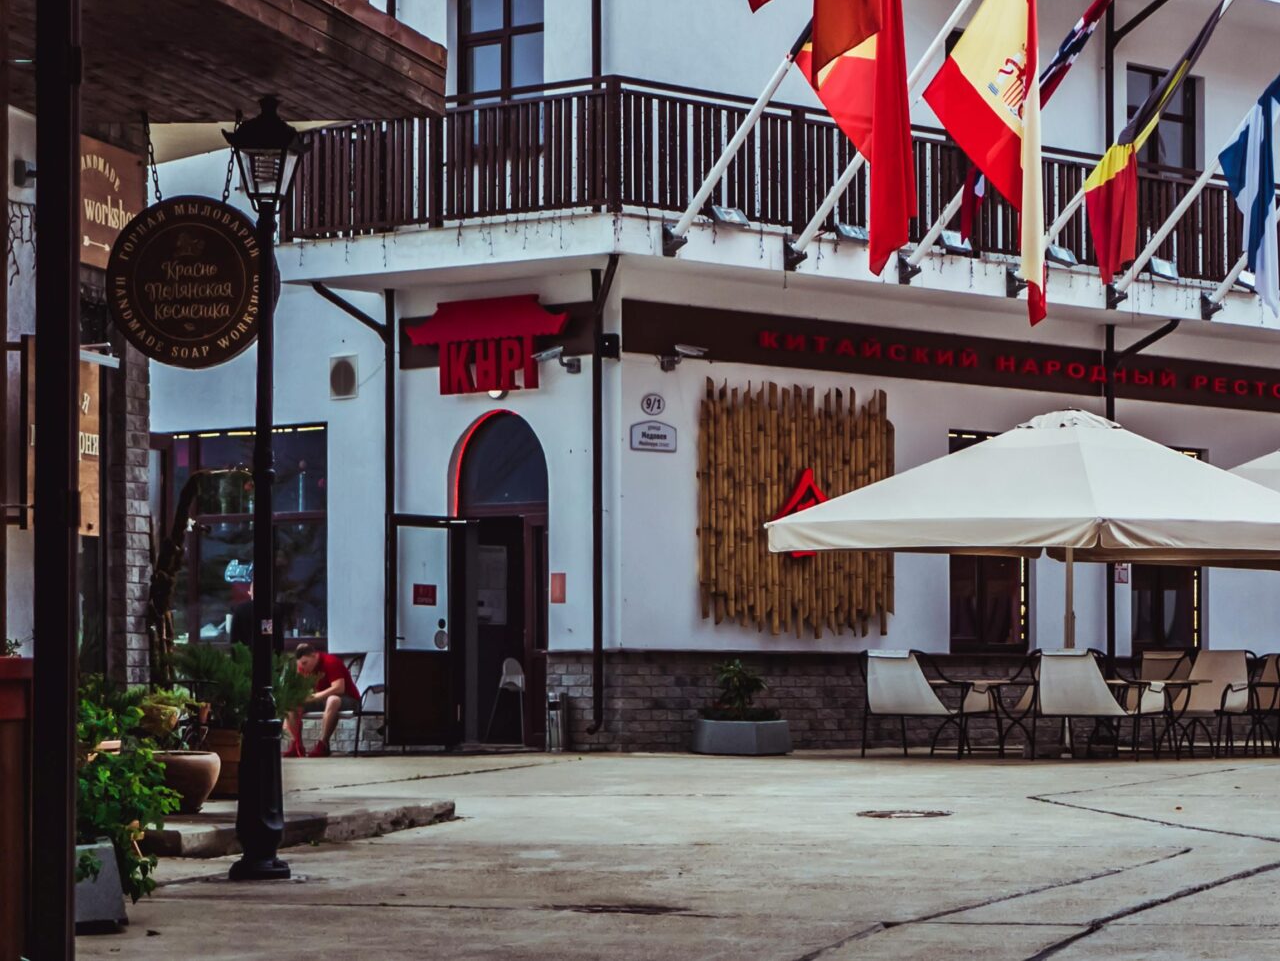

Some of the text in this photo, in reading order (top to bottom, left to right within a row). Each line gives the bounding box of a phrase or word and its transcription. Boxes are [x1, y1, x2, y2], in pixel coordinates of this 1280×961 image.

[80, 153, 121, 192] ANDMADE
[84, 195, 137, 231] worksho
[119, 203, 260, 261] ГОРНАЯ МЫЛОВАРНЯ
[161, 260, 218, 281] Красно
[115, 276, 165, 353] HANDMADE
[171, 344, 210, 359] SOAP
[759, 329, 980, 369] КИТАЙСКИЙ
[995, 354, 1177, 389] НАРОДНЫЙ
[645, 397, 662, 413] 9/1
